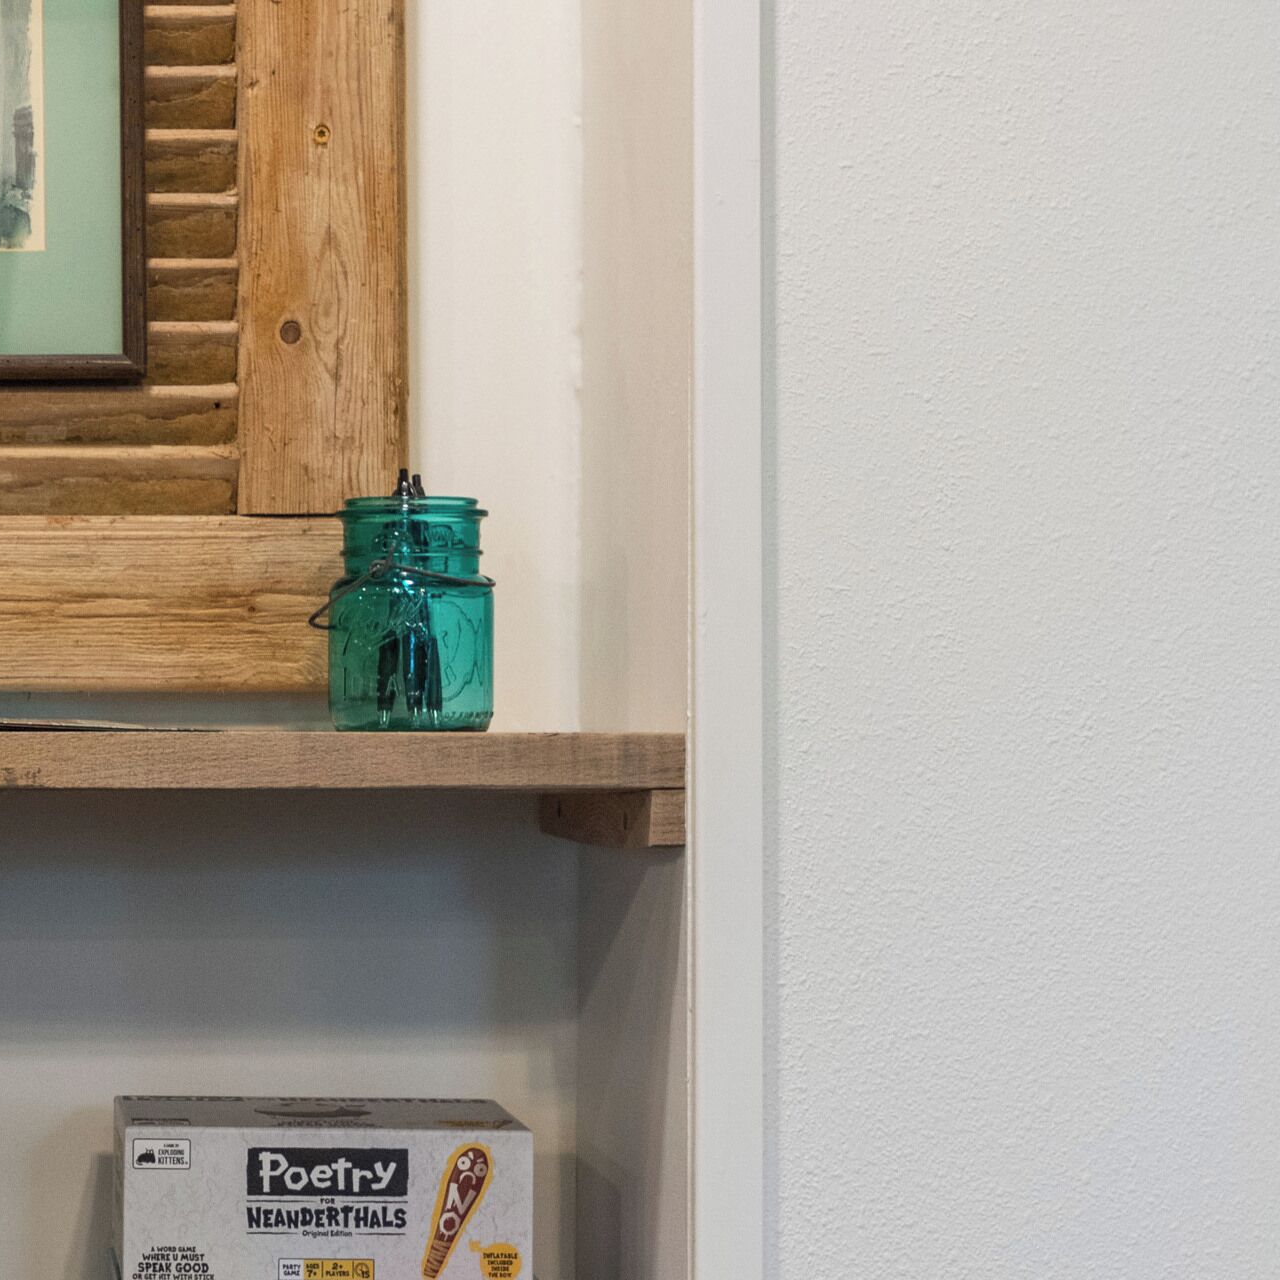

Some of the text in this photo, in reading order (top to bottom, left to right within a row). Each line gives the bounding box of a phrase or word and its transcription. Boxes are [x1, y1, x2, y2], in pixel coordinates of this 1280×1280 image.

[158, 1156, 185, 1165] KITTENS
[258, 1151, 397, 1193] Poetry
[247, 1205, 407, 1229] NEANDERTHALS
[302, 1230, 329, 1238] Original
[142, 1253, 205, 1261] WHERE U MUST
[138, 1262, 209, 1273] SPEAK GOOD
